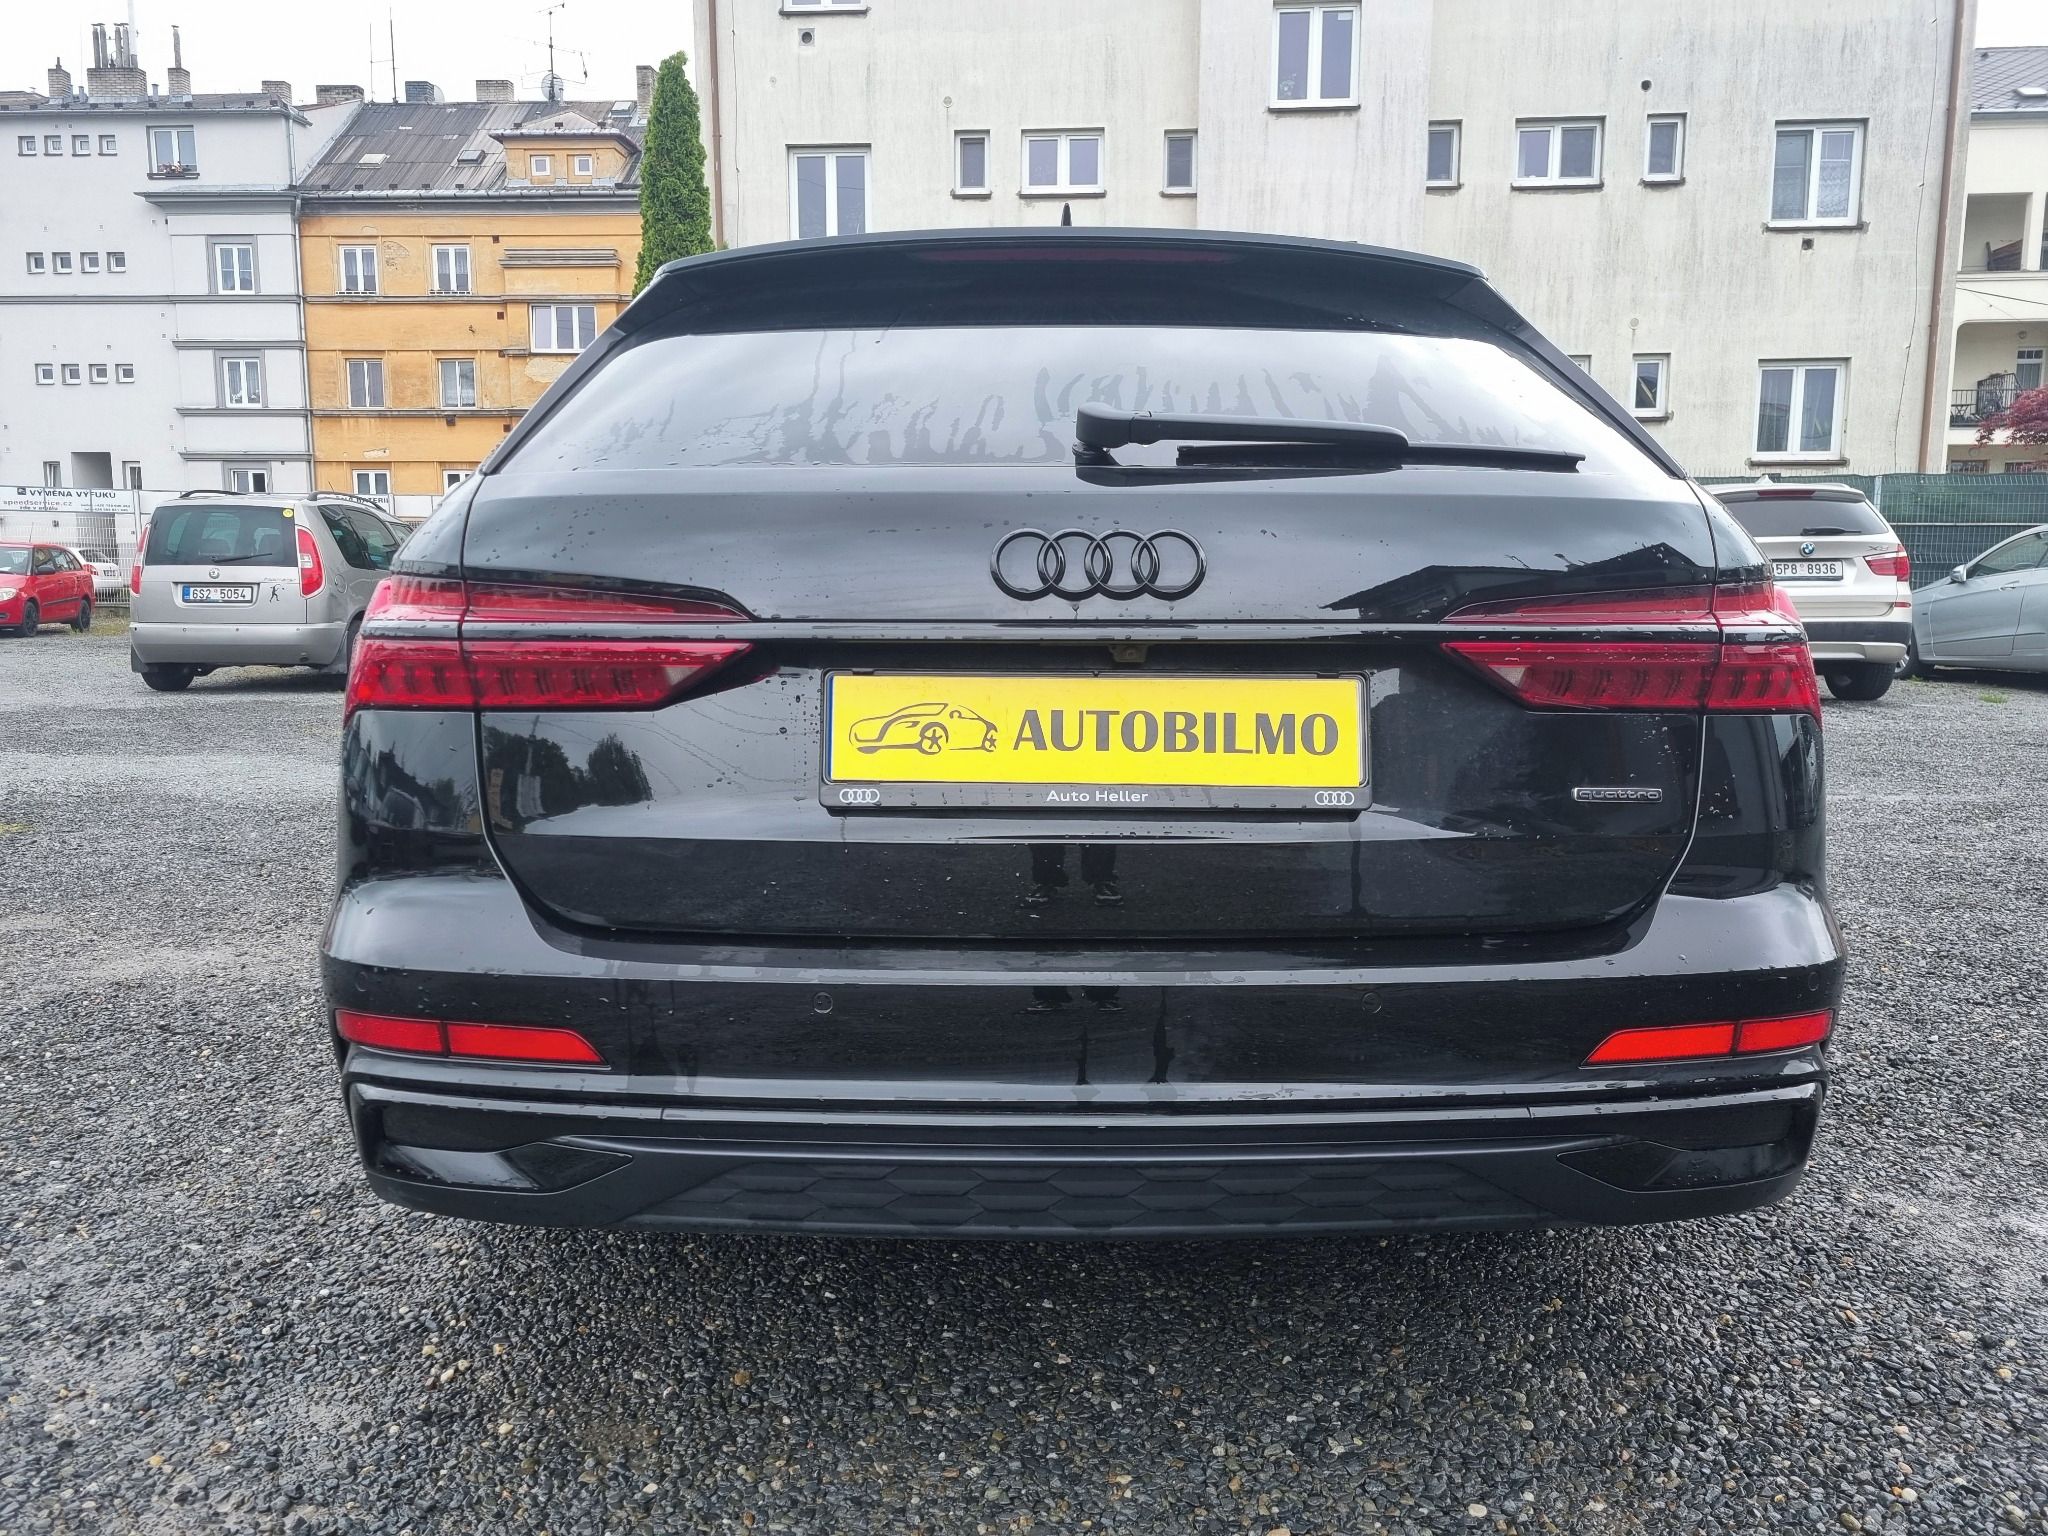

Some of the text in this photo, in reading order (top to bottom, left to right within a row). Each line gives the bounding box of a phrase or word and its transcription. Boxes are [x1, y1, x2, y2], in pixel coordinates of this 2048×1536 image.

[1775, 563, 1837, 575] 5P8 8936
[192, 588, 246, 600] 6S2 5054
[1013, 709, 1339, 756] AUTOBILMO
[1046, 789, 1149, 803] Auto Heller
[1580, 790, 1659, 800] quattro
